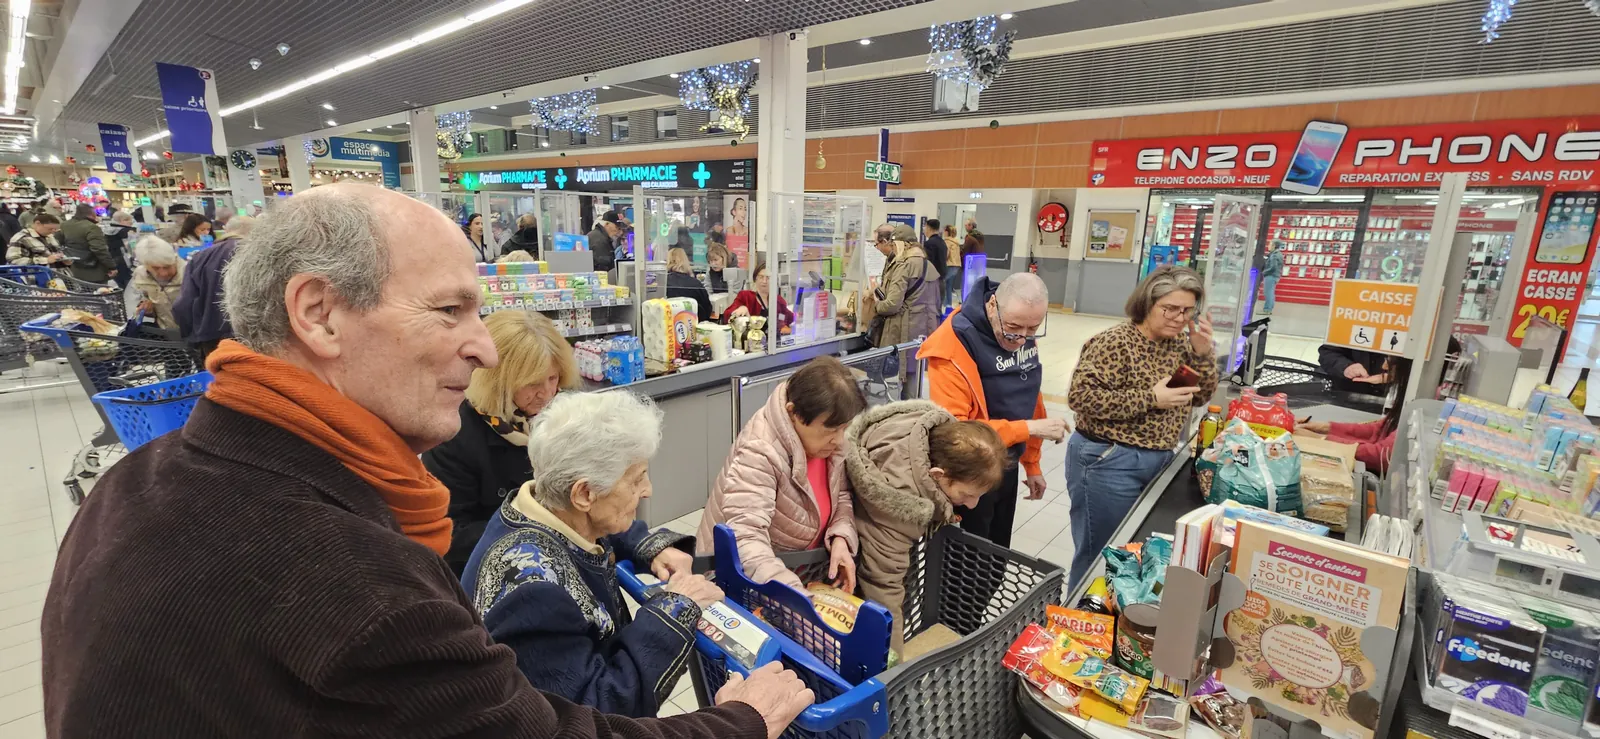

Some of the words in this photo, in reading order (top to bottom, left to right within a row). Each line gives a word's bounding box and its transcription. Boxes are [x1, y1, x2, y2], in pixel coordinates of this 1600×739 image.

[104, 151, 133, 159] articles
[1136, 144, 1278, 171] ENZO
[1353, 132, 1600, 166] PHONE
[501, 170, 547, 184] PHARMACIE
[576, 168, 610, 184] Aprium
[611, 165, 678, 181] PHARMACIE
[1134, 176, 1184, 185] TELEPHONE
[1186, 175, 1236, 184] OCCASION
[1243, 174, 1271, 183] NEUF
[1339, 172, 1420, 183] REPARATION
[1424, 171, 1490, 182] EXESS
[1511, 170, 1554, 181] SANS
[1558, 169, 1594, 181] RDV
[660, 222, 669, 236] 8
[1381, 255, 1403, 282] 9
[1526, 269, 1582, 284] ECRAN
[1359, 289, 1413, 307] CAISSE
[1523, 285, 1577, 300] CASSÉ
[1335, 308, 1412, 327] PRIORITAI
[996, 355, 1015, 371] San
[1251, 426, 1279, 436] OFFERT
[1273, 546, 1313, 565] Secrets
[1314, 555, 1362, 577] d'antan
[1259, 560, 1274, 570] SE
[1276, 562, 1371, 600] SOIGNER
[1258, 569, 1302, 590] TOUTE
[1307, 583, 1369, 612] L'ANNÉE
[704, 604, 726, 622] clerc
[1051, 613, 1106, 636] HARIBO
[1448, 638, 1531, 673] Freedent
[1540, 647, 1595, 669] edent
